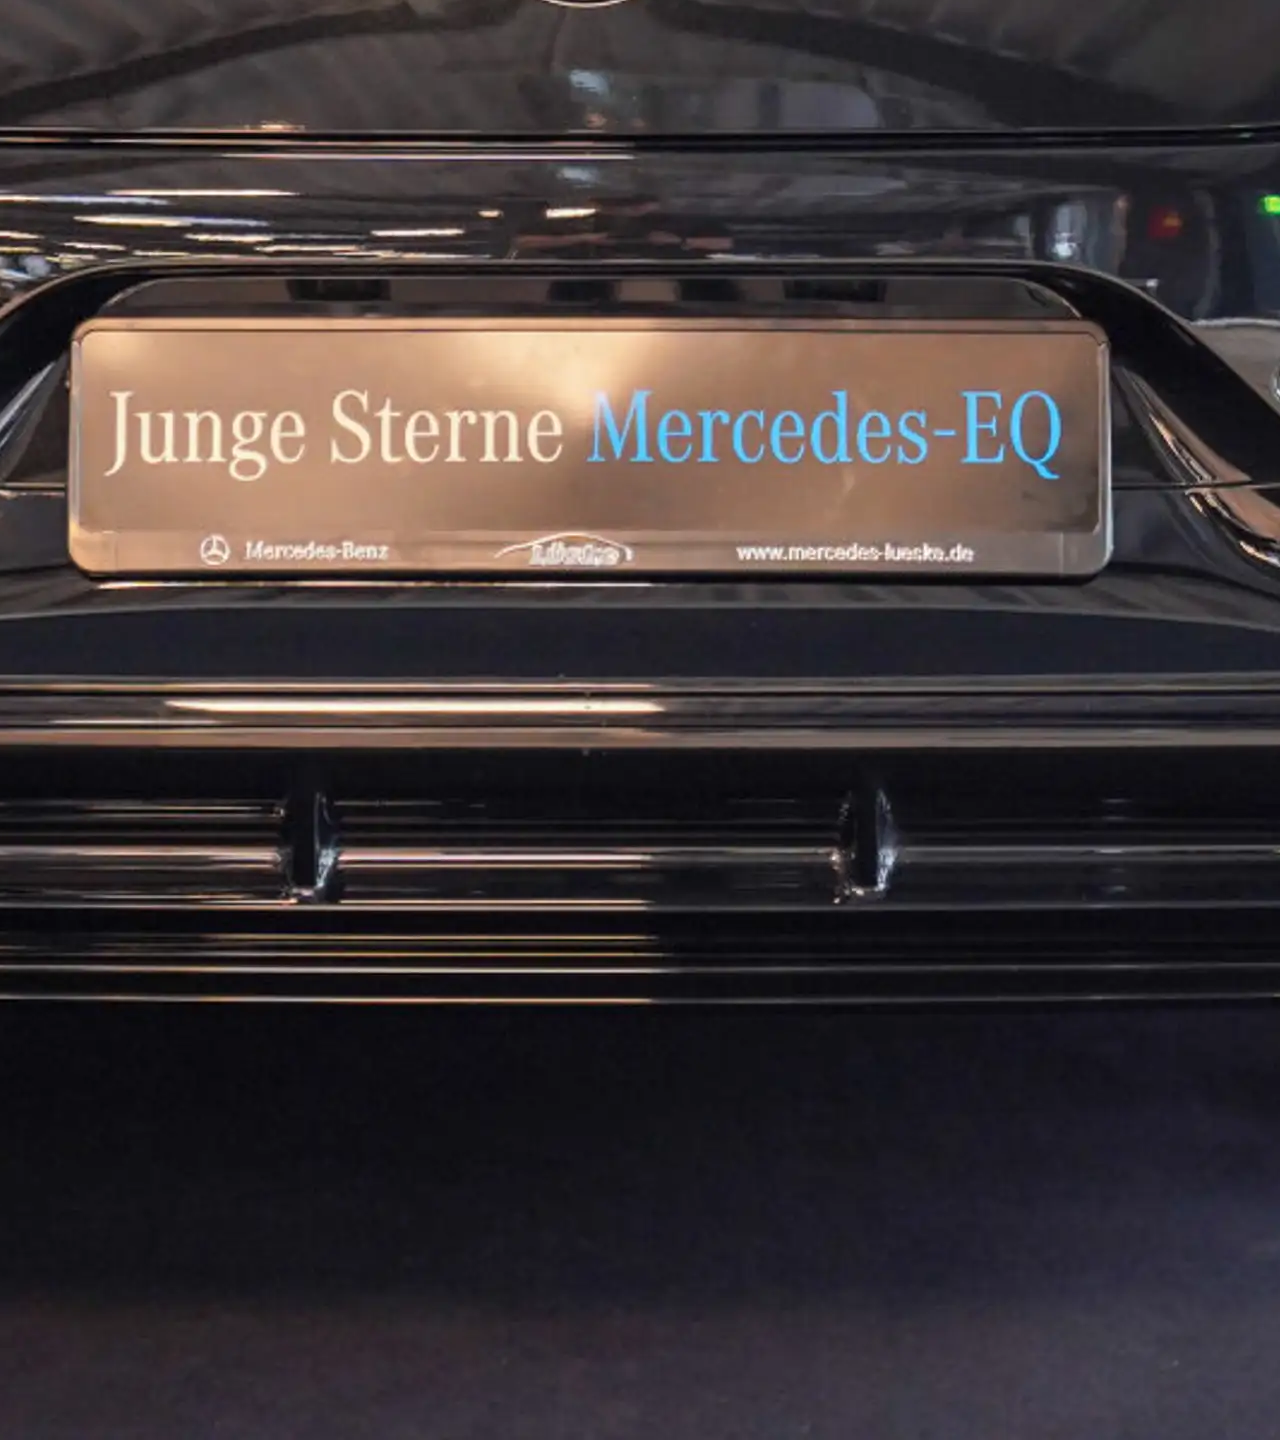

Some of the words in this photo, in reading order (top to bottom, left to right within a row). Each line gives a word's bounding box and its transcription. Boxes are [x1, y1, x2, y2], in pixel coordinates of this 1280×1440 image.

[103, 389, 307, 482] Junge
[329, 388, 564, 464] Sterne
[585, 388, 1063, 480] Mercedes-EQ
[244, 540, 390, 561] Mercedes-Benz
[735, 542, 975, 562] www.mercedes-lueske.de
